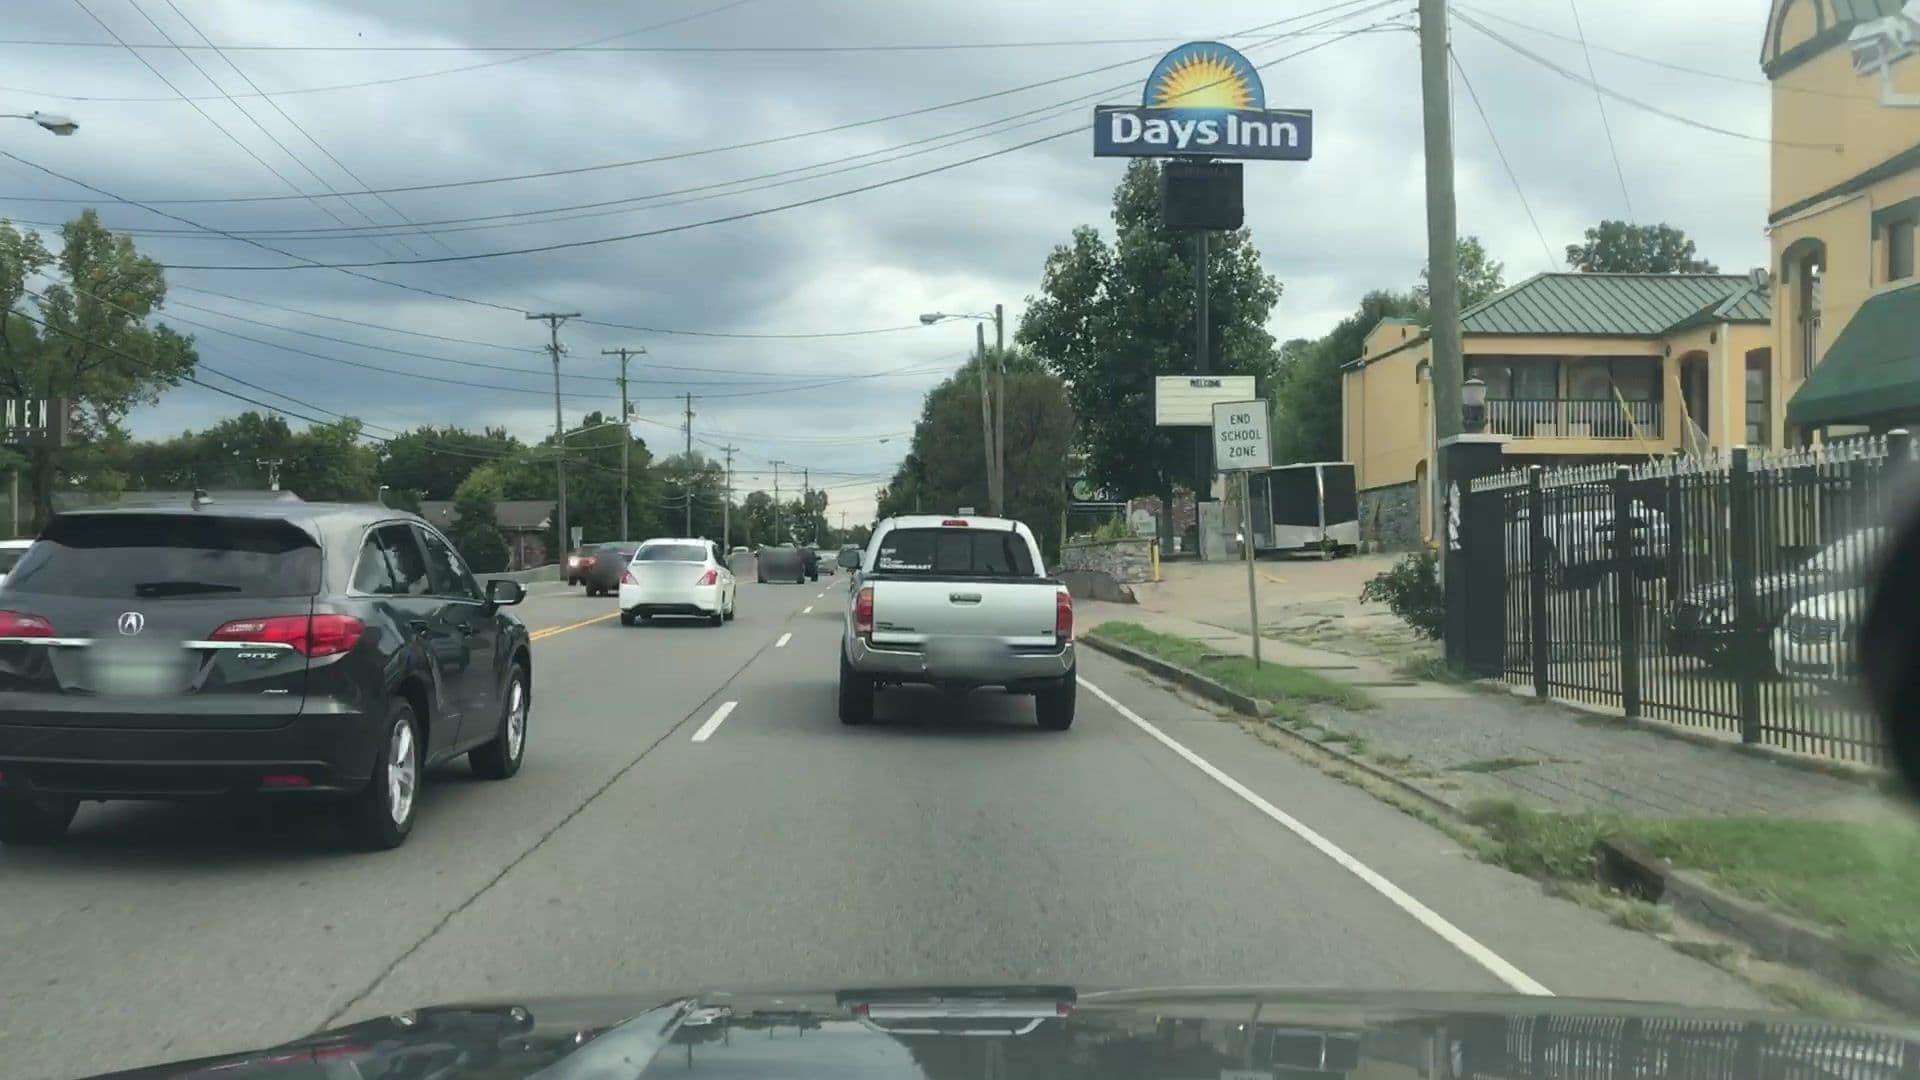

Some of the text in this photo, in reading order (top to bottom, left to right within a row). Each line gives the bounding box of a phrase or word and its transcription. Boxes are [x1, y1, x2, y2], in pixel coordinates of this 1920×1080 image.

[1111, 112, 1298, 149] Days Inn
[1230, 413, 1251, 425] END
[1221, 429, 1262, 441] SCHOOL
[1229, 446, 1256, 458] ZONE
